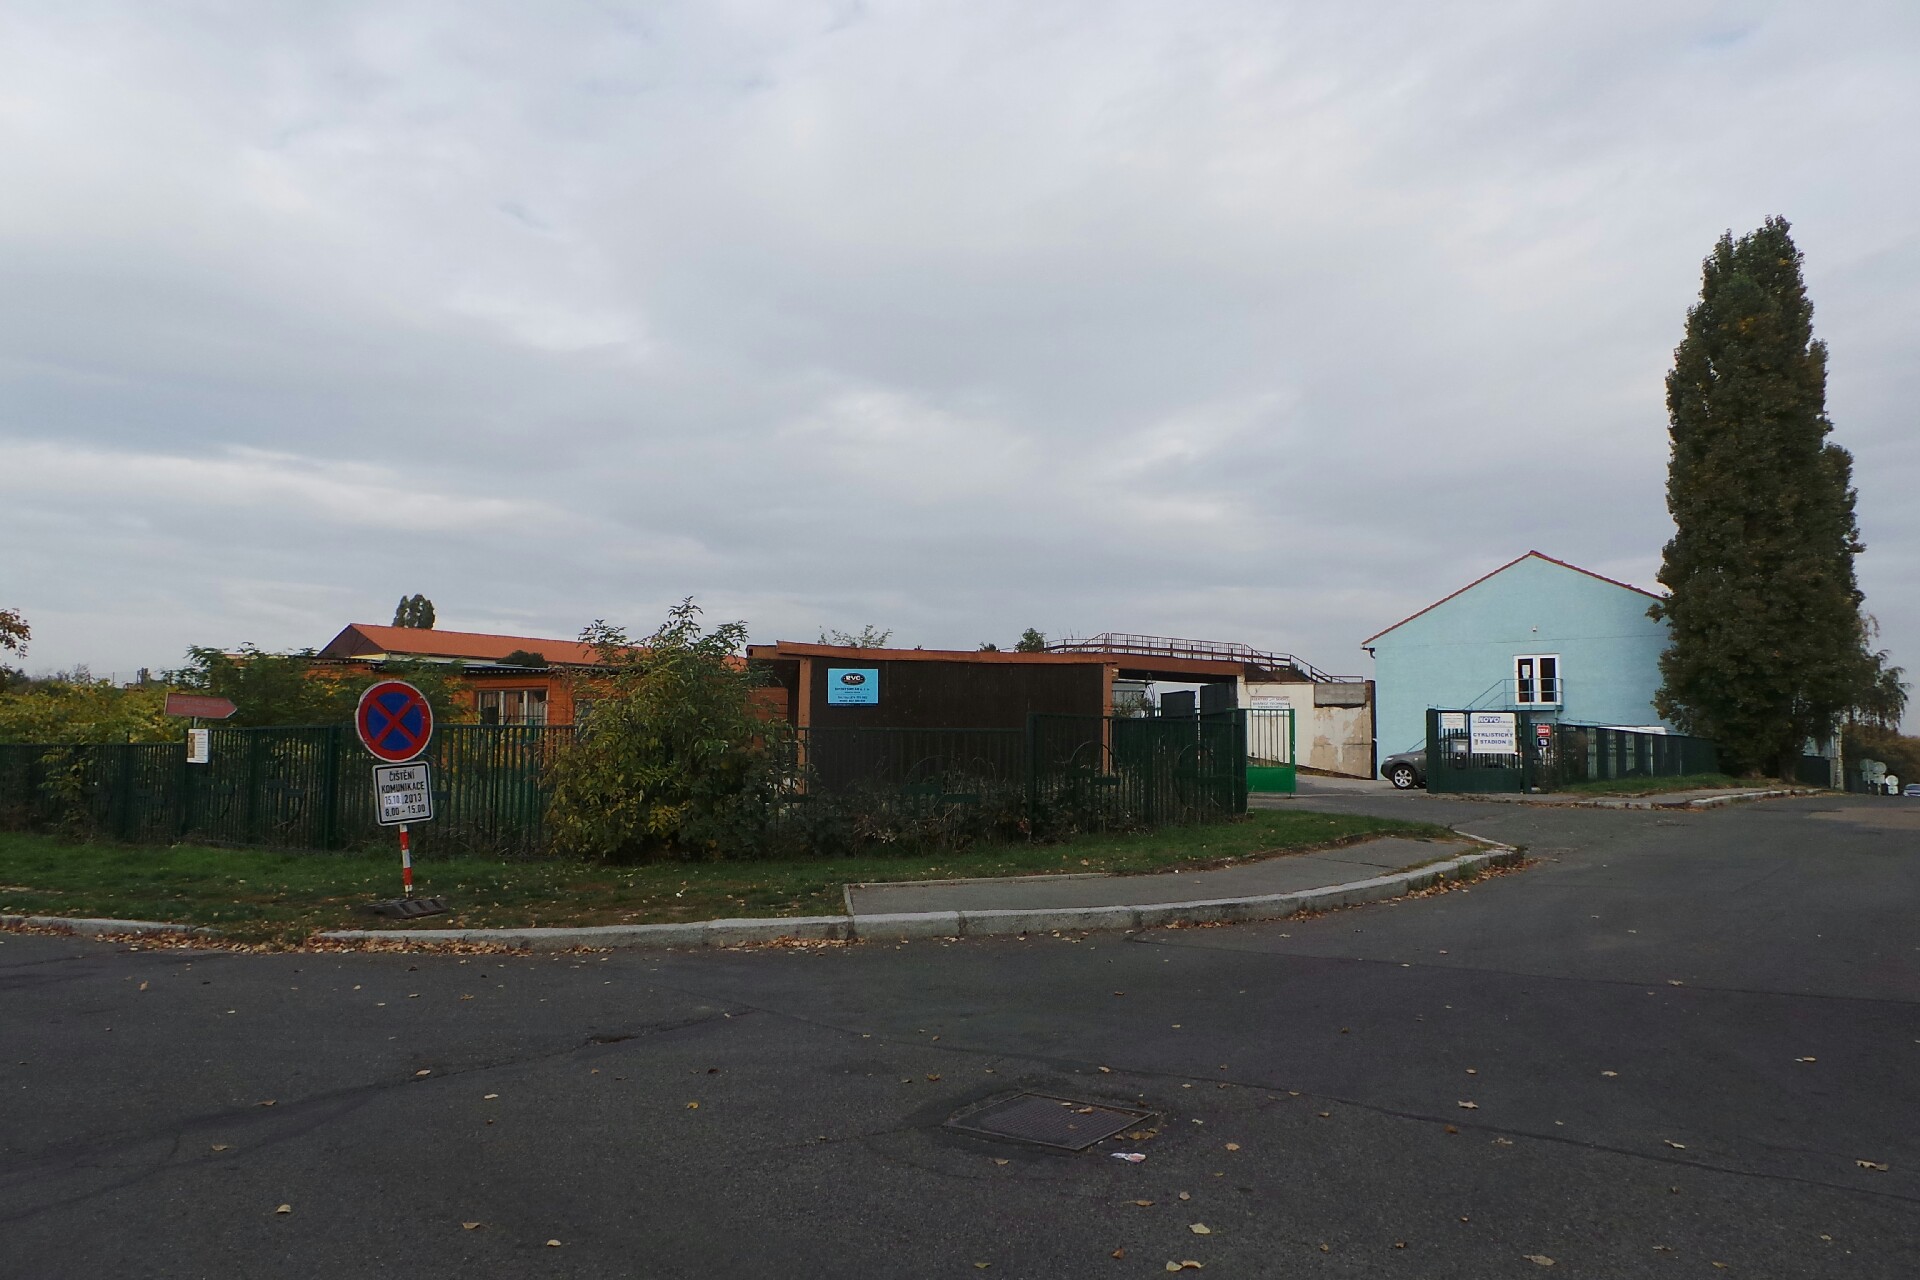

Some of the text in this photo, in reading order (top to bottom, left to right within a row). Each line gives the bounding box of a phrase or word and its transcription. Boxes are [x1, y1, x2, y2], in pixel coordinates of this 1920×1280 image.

[389, 769, 415, 781] ČIŠTĚNÍ
[381, 781, 425, 793] KOMUNIKACE
[385, 807, 400, 817] 8.00
[407, 804, 426, 814] 15.00
